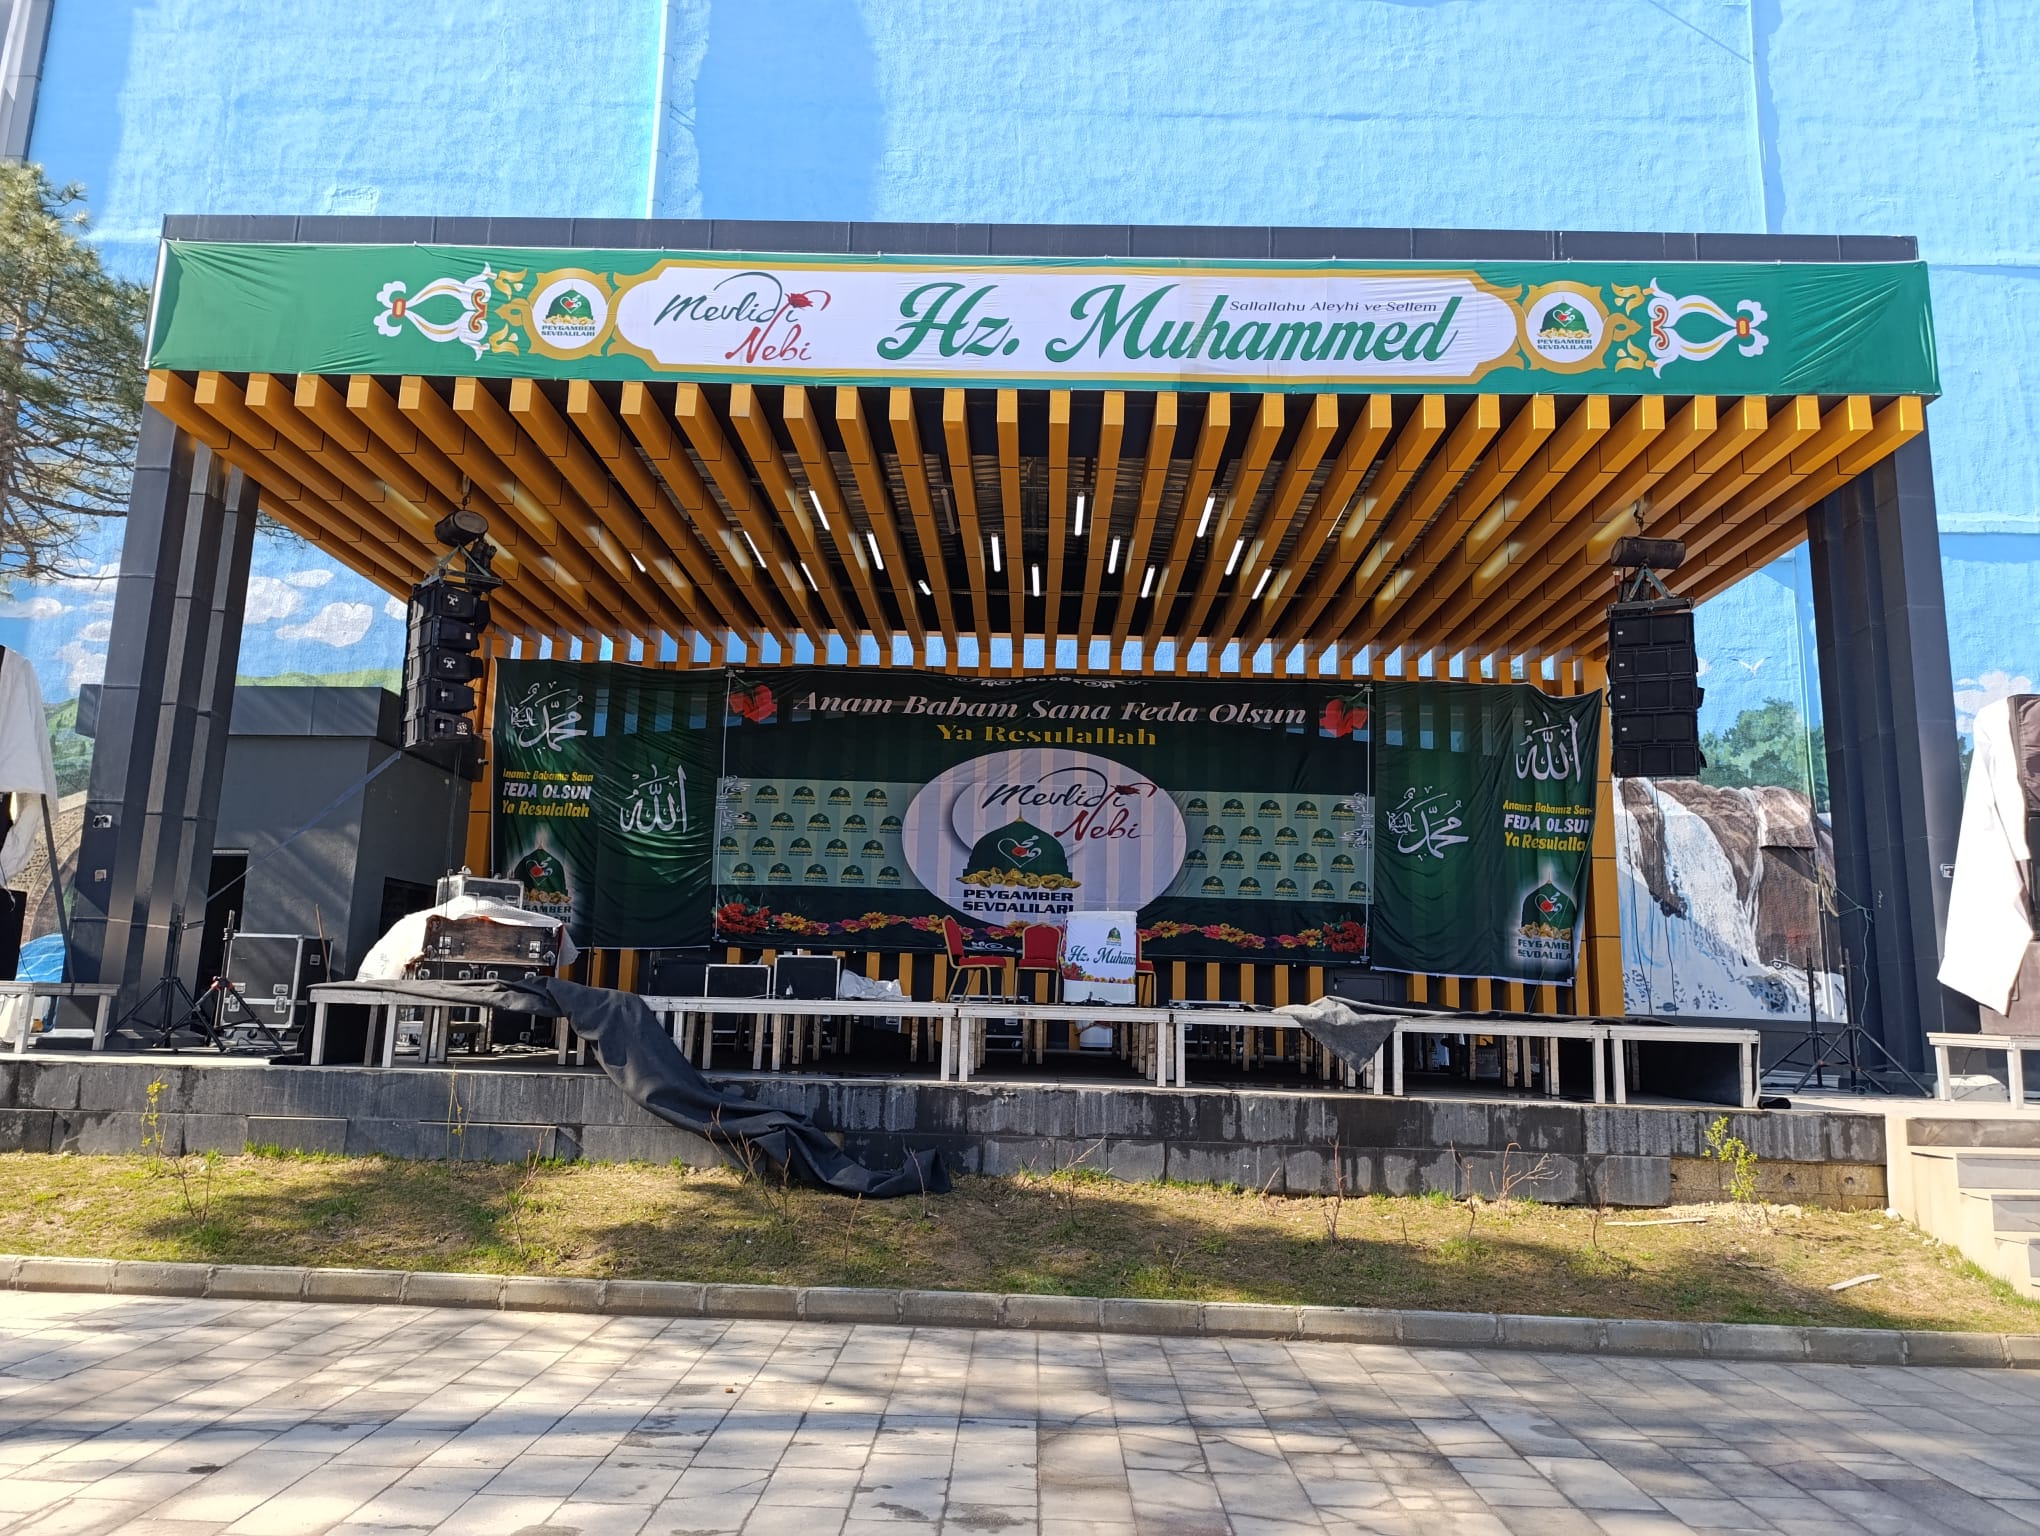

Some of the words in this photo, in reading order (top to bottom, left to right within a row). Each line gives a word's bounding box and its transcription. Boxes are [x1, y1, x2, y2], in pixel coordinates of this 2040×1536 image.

[1229, 300, 1306, 312] Sallallahu
[1310, 301, 1359, 314] Aleyhi
[1364, 303, 1383, 312] ve
[1387, 301, 1437, 312] Sellem
[877, 282, 1020, 362] Hz.
[1045, 283, 1462, 363] Muhammed
[725, 323, 813, 364] Nebi
[792, 691, 893, 714] Anam
[901, 695, 1018, 718] Babam
[1027, 699, 1111, 720] Sana
[1120, 701, 1199, 722] Feda
[1209, 703, 1306, 725] Olsun
[936, 724, 973, 741] Ya
[985, 726, 1156, 745] Resulallah
[571, 772, 594, 782] Sana
[503, 781, 538, 798] FEDA
[543, 784, 592, 800] OLSUN
[502, 799, 515, 815] Ya
[518, 800, 590, 818] Resulallah
[1054, 807, 1141, 841] Nebi
[1504, 814, 1541, 831] FEDA
[1504, 831, 1520, 847] Ya
[1522, 834, 1586, 851] Resulalla
[963, 889, 1074, 902] PEYGAMBER
[523, 905, 572, 914] GAMBER
[963, 901, 1074, 914] SEVDALILARI
[1068, 945, 1090, 962] Hz.
